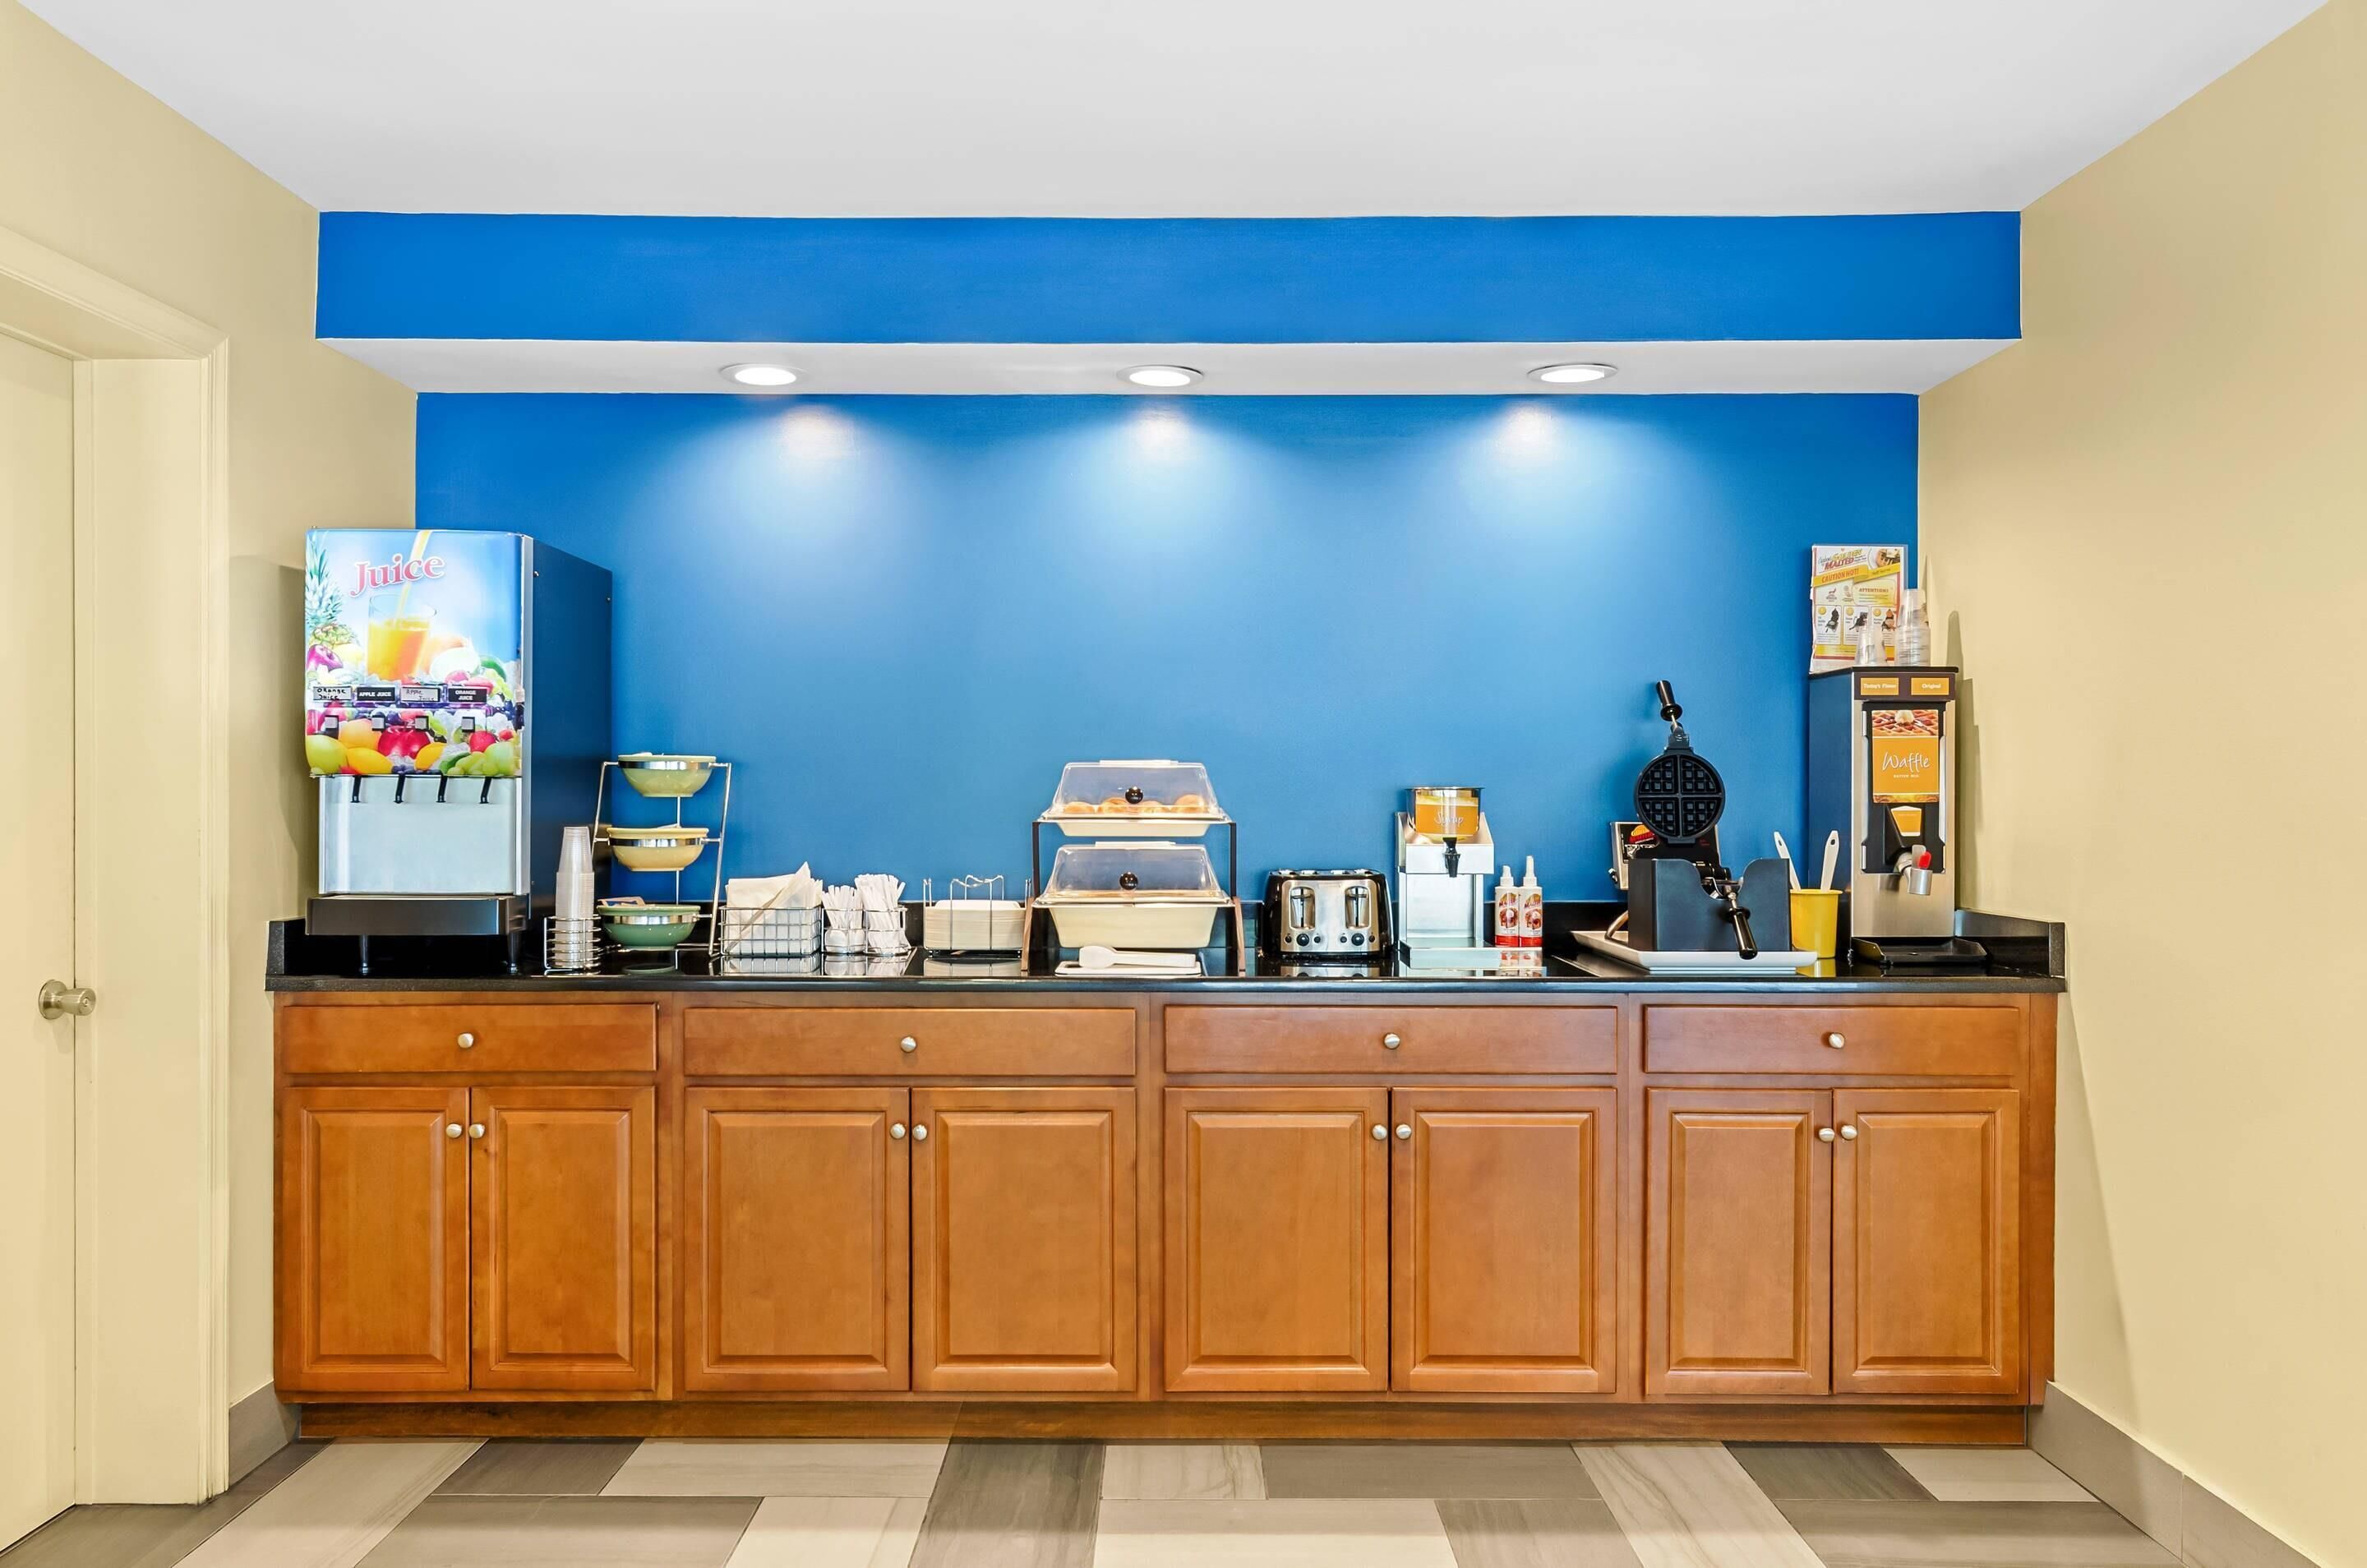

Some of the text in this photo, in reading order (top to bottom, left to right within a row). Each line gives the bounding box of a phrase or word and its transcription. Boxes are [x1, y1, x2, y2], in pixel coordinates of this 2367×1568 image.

[350, 554, 444, 597] Juice
[1821, 571, 1844, 583] CAUTION
[1882, 751, 1931, 772] Waffle
